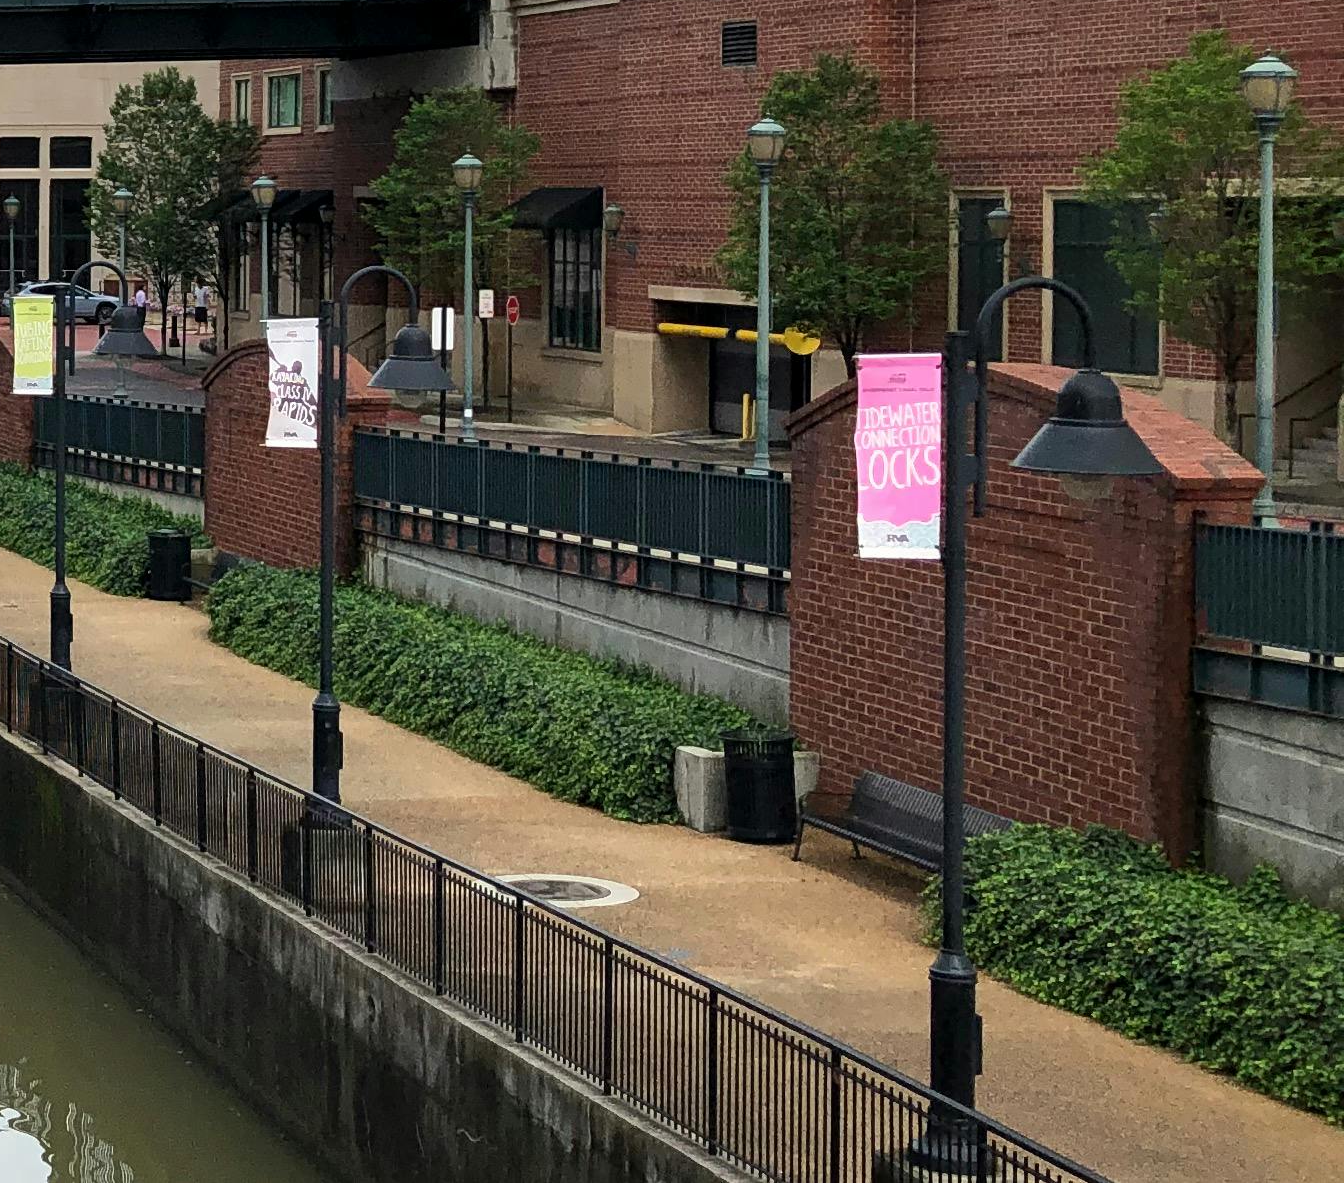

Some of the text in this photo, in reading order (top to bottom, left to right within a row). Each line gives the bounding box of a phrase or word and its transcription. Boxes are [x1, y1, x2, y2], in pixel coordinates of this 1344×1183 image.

[276, 384, 301, 400] CLASS
[272, 397, 318, 426] RAPIDS
[857, 401, 941, 430] TIDEWATER
[854, 425, 941, 450] CONNECTION
[887, 534, 910, 543] RVA
